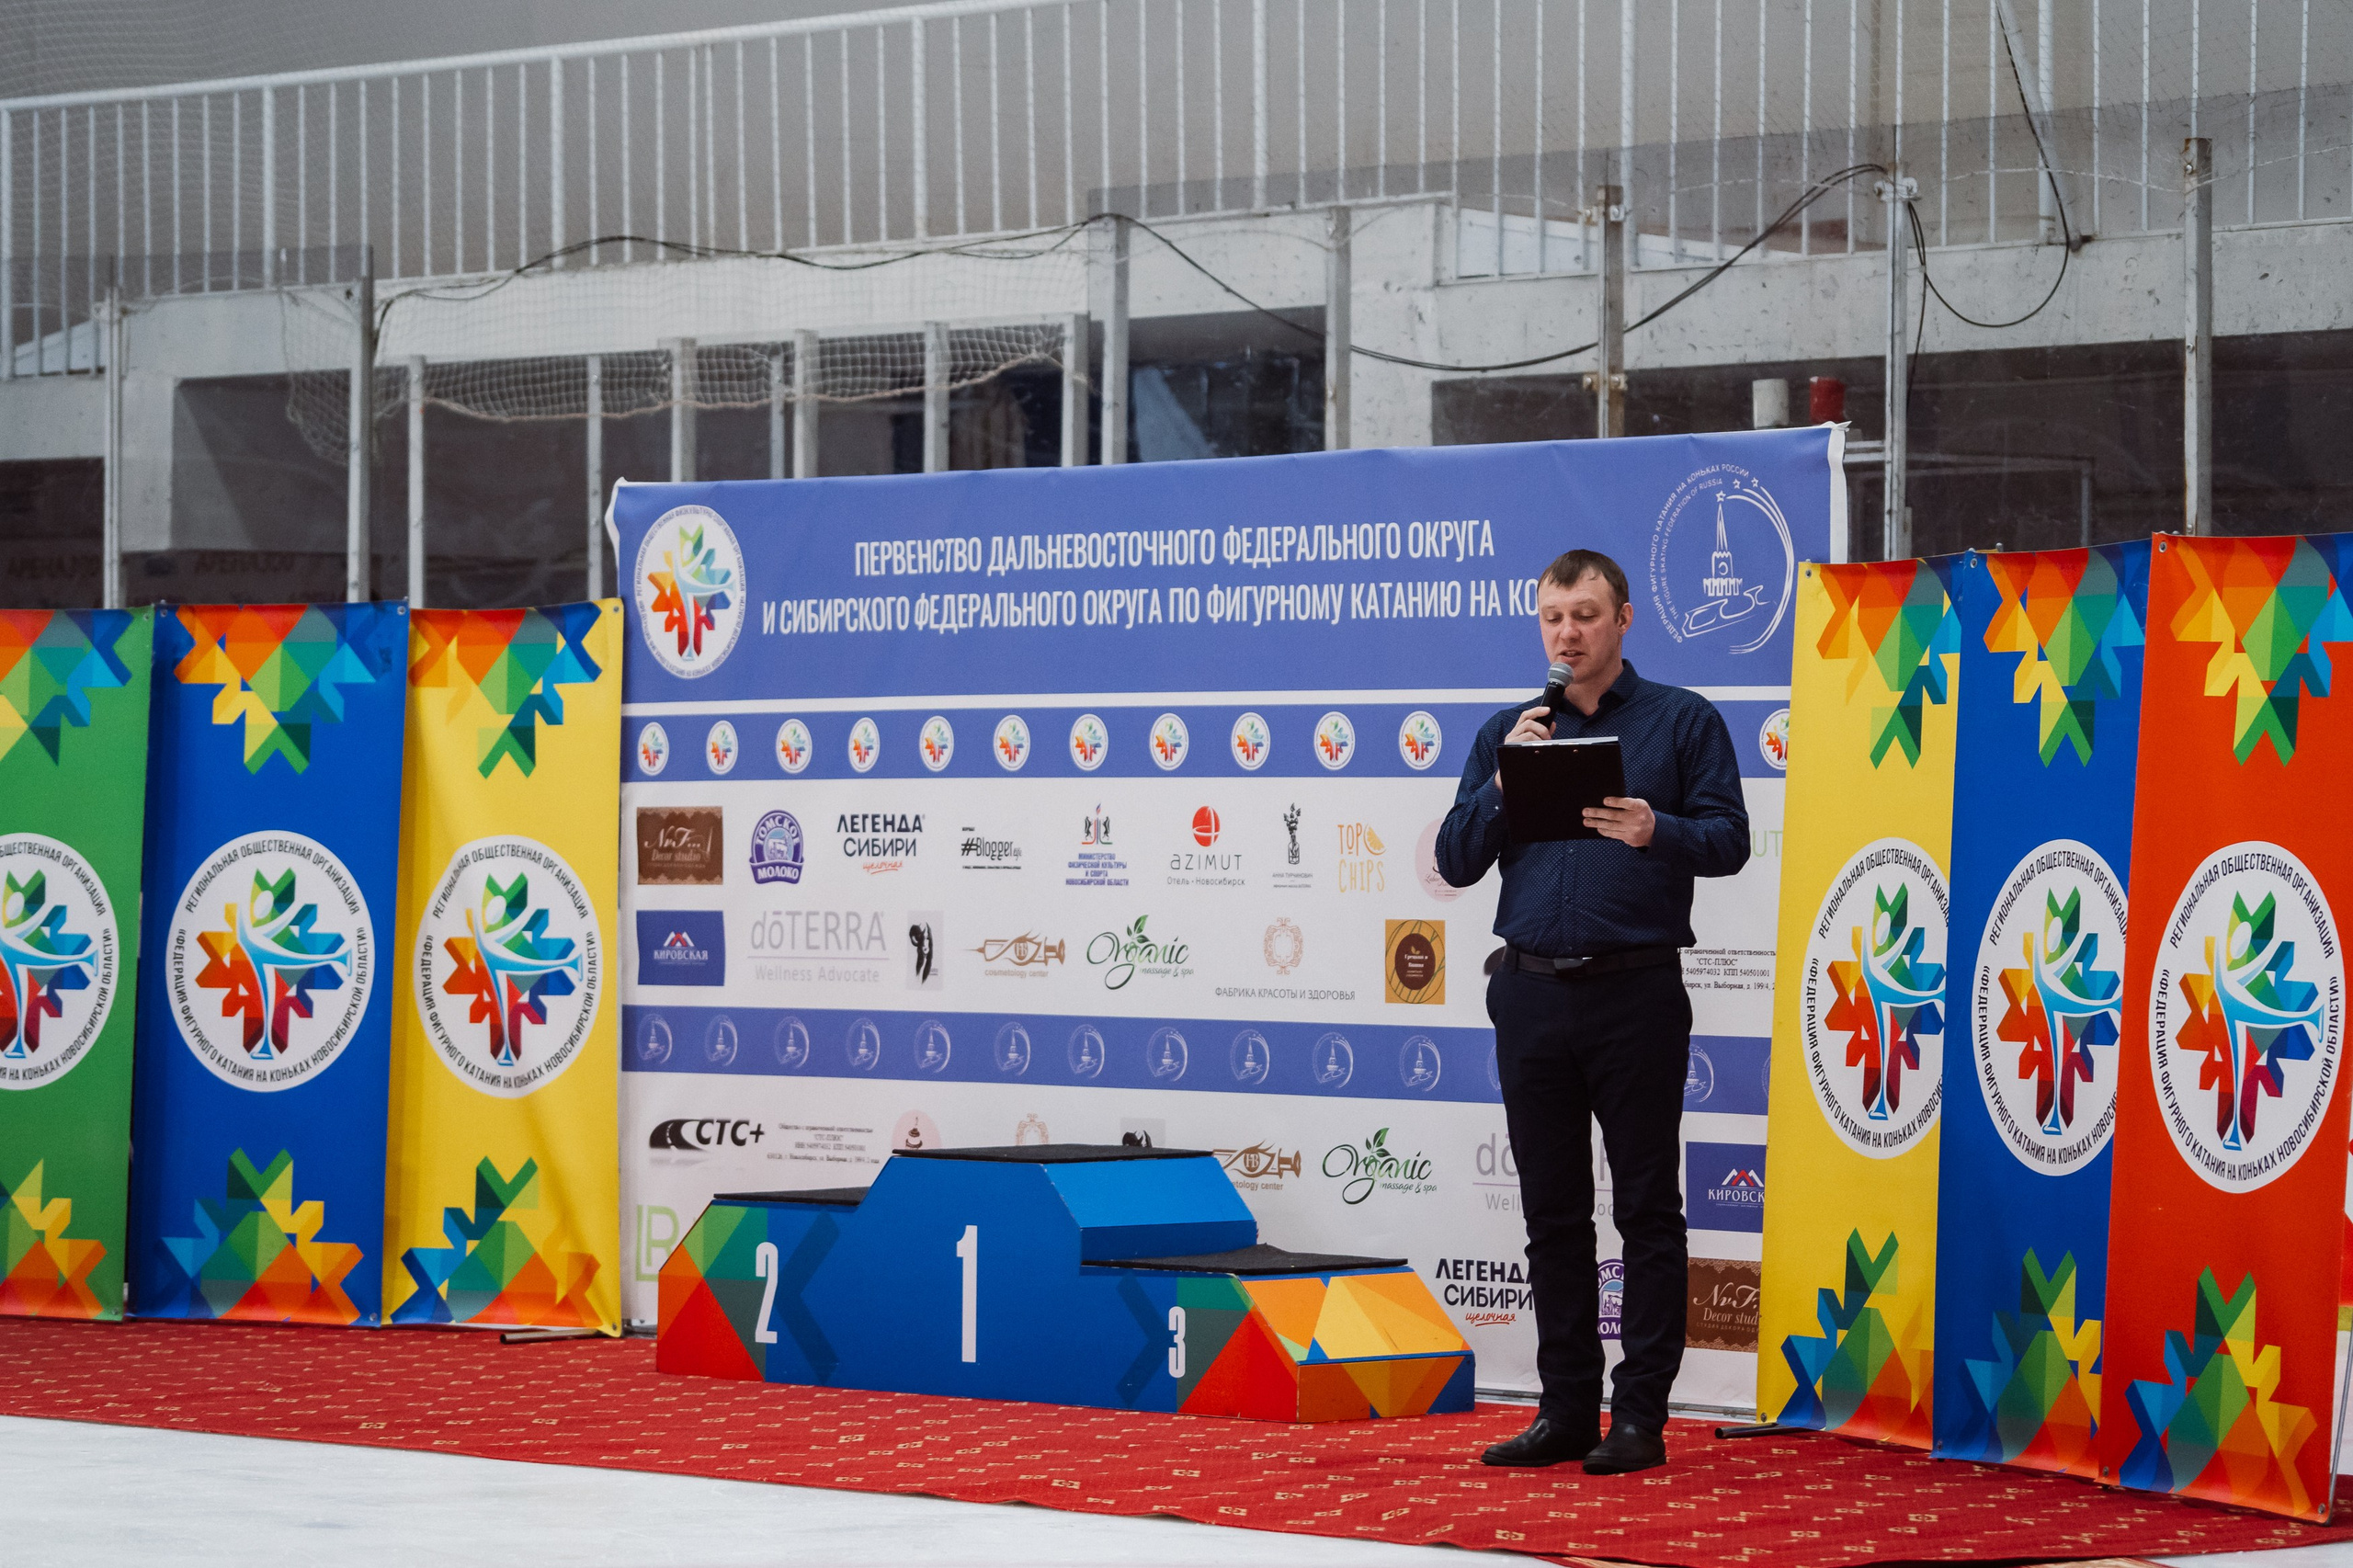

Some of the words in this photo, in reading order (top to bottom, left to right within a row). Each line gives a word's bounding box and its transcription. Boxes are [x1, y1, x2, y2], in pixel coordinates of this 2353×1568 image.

[1687, 464, 1721, 484] КОНЬКАХ
[1699, 478, 1723, 490] RUSSIA
[1722, 463, 1750, 478] РОССИИ
[1676, 483, 1688, 494] НА
[1689, 487, 1699, 497] OF
[1655, 493, 1677, 532] КАТАНИЯ
[1664, 495, 1691, 537] FEDERATION
[855, 537, 983, 576] ПЕРВЕНСТВО
[987, 528, 1215, 576] ДАЛЬНЕВОСТОЧНОГО
[1222, 521, 1401, 569] ФЕДЕРАЛЬНОГО
[1408, 519, 1495, 562] ОКРУГА
[1650, 534, 1660, 593] ФИГУРНОГО
[1660, 539, 1669, 574] SKATING
[762, 601, 776, 634] И
[779, 596, 910, 634] СИБИРСКОГО
[914, 590, 1076, 634] ФЕДЕРАЛЬНОГО
[1083, 587, 1162, 630] ОКРУГА
[1169, 586, 1200, 623] ПО
[1207, 583, 1344, 627] ФИГУРНОМУ
[1351, 580, 1461, 619] КАТАНИЮ
[1471, 579, 1502, 618] НА
[1661, 574, 1673, 607] FIGURE
[1653, 596, 1683, 643] ФЕДЕРАЦИЯ
[1667, 607, 1679, 620] THE
[756, 815, 801, 845] ТОМСКОЕ
[837, 813, 923, 833] ЛЕГЕНДА
[1337, 823, 1363, 856] TOP
[844, 837, 916, 857] СИБИРИ
[0, 841, 63, 863] БЩЕСТВЕННАЯ
[62, 855, 107, 916] ОРГАНИЗАЦИЯ
[185, 849, 240, 913] РЕГИОНАЛЬНАЯ
[240, 838, 312, 861] ОБЩЕСТВЕННАЯ
[313, 851, 361, 915] ОРГАНИЗАЦИЯ
[432, 855, 472, 919] РЕГИОНАЛЬНАЯ
[472, 844, 543, 864] ОБЩЕСТВЕННАЯ
[542, 857, 588, 919] ОРГАНИЗАЦИЯ
[757, 865, 799, 880] МОЛОКО
[1167, 876, 1190, 885] Отель
[1195, 876, 1245, 886] Новосибирск
[1338, 858, 1385, 893] CHIPS
[1818, 860, 1866, 939] РЕГИОНАЛЬНАЯ
[1866, 848, 1922, 874] ОБЩЕСТВЕННАЯ
[1990, 865, 2036, 946] РЕГИОНАЛЬНАЯ
[2036, 850, 2095, 878] ОБЩЕСТВЕННАЯ
[2169, 865, 2220, 949] РЕГИОНАЛЬНАЯ
[2221, 853, 2294, 883] ОБЩЕСТВЕННАЯ
[2291, 872, 2335, 960] ОРГАНИЗАЦИЯ
[654, 949, 708, 960] КИРОВСКАЯ
[1086, 930, 1189, 990] Organic
[755, 965, 813, 982] Wellness
[818, 965, 881, 983] Advocate
[985, 969, 1027, 978] cosmetology
[1181, 968, 1195, 979] spa
[1215, 987, 1256, 999] ФАБРИКА
[1258, 988, 1298, 999] КРАСОТЫ
[1300, 990, 1305, 999] И
[1308, 989, 1356, 1001] ЗДОРОВЬЯ
[8, 1068, 21, 1081] НА
[22, 1058, 61, 1081] КОНЬКАХ
[60, 986, 109, 1066] НОВОСИБИРСКОЙ
[181, 1005, 218, 1060] ФИГУРНОГО
[216, 1050, 255, 1081] КАТАНИЯ
[256, 1070, 268, 1083] НА
[270, 1058, 312, 1083] КОНЬКАХ
[310, 985, 365, 1066] НОВОСИБИРСКОЙ
[429, 1012, 465, 1066] ФИГУРНОГО
[464, 1062, 502, 1087] КАТАНИЯ
[504, 1077, 513, 1088] НА
[514, 1067, 545, 1088] КОНЬКАХ
[544, 992, 595, 1073] НОВОСИБИРСКОЙ
[1811, 1048, 1841, 1119] ФИГУРНОГО
[1838, 1112, 1870, 1147] КАТАНИЯ
[1872, 1133, 1882, 1148] НА
[1883, 1119, 1918, 1148] КОНЬКАХ
[1984, 1059, 2014, 1133] ФИГУРНОГО
[2012, 1126, 2046, 1162] КАТАНИЯ
[2046, 1150, 2057, 1165] НА
[2058, 1135, 2093, 1165] КОНЬКАХ
[696, 1118, 765, 1147] СТС+
[2160, 1070, 2192, 1146] ФИГУРНОГО
[2190, 1138, 2226, 1177] КАТАНИЯ
[2226, 1165, 2237, 1180] НА
[2238, 1150, 2277, 1181] КОНЬКАХ
[2276, 1056, 2334, 1163] НОВОСИБИРСКОЙ
[1322, 1142, 1433, 1205] Organic
[1380, 1182, 1413, 1194] massage
[1424, 1183, 1437, 1193] spa
[1708, 1188, 1765, 1203] КИРОВСК
[755, 1242, 778, 1344] 2
[956, 1225, 977, 1363] 1
[1443, 1283, 1533, 1311] СИБИРИ
[1465, 1312, 1517, 1324] щелочная
[1703, 1307, 1733, 1323] Decor
[1735, 1312, 1758, 1325] stud
[1168, 1306, 1186, 1378] 3
